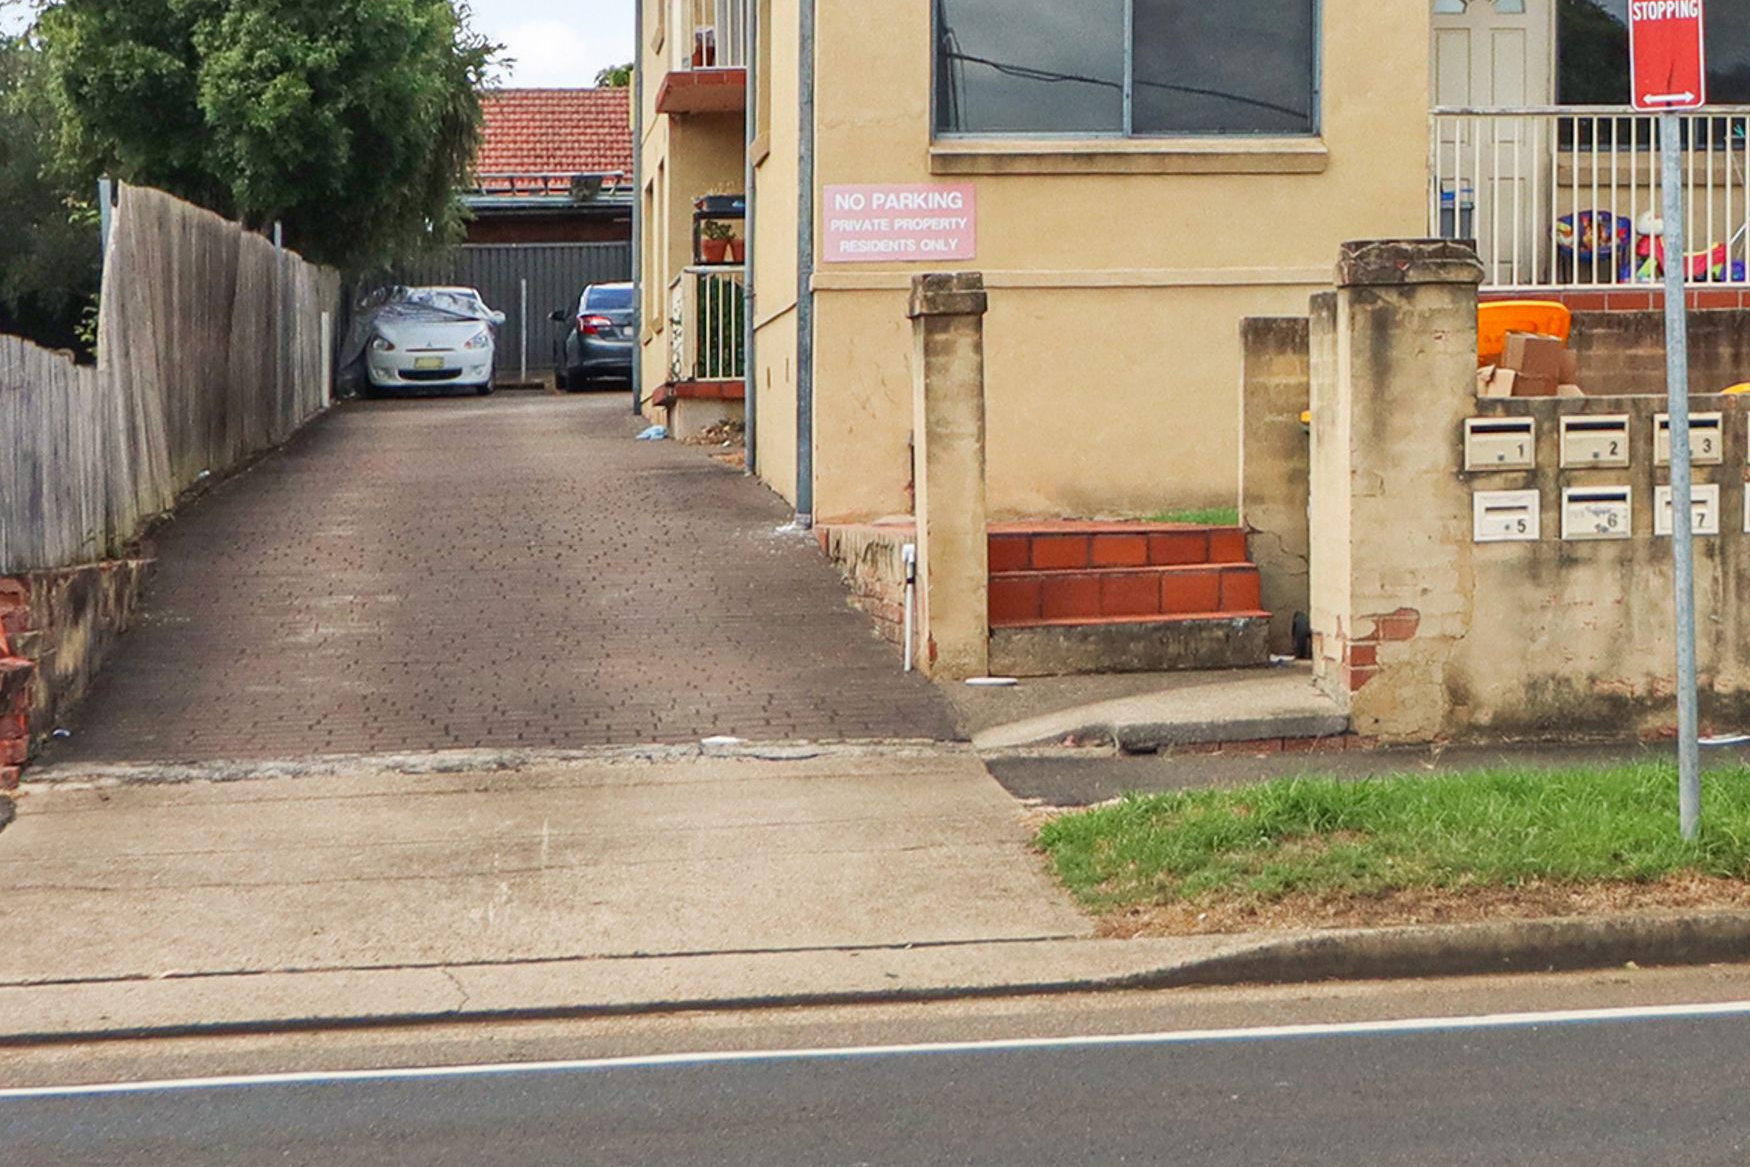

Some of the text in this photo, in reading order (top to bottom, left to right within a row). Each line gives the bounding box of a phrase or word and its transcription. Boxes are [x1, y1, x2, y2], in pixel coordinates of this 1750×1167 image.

[835, 191, 963, 210] NO PARKING
[831, 217, 967, 231] PRIVATE PROPERTY
[840, 238, 958, 253] RESIDENTS ONLY
[1518, 444, 1525, 457] 1
[1609, 441, 1618, 456] 2
[1703, 438, 1712, 453] 3
[1517, 519, 1526, 533] 5
[1607, 513, 1618, 528] 6
[1696, 513, 1706, 528] 7
